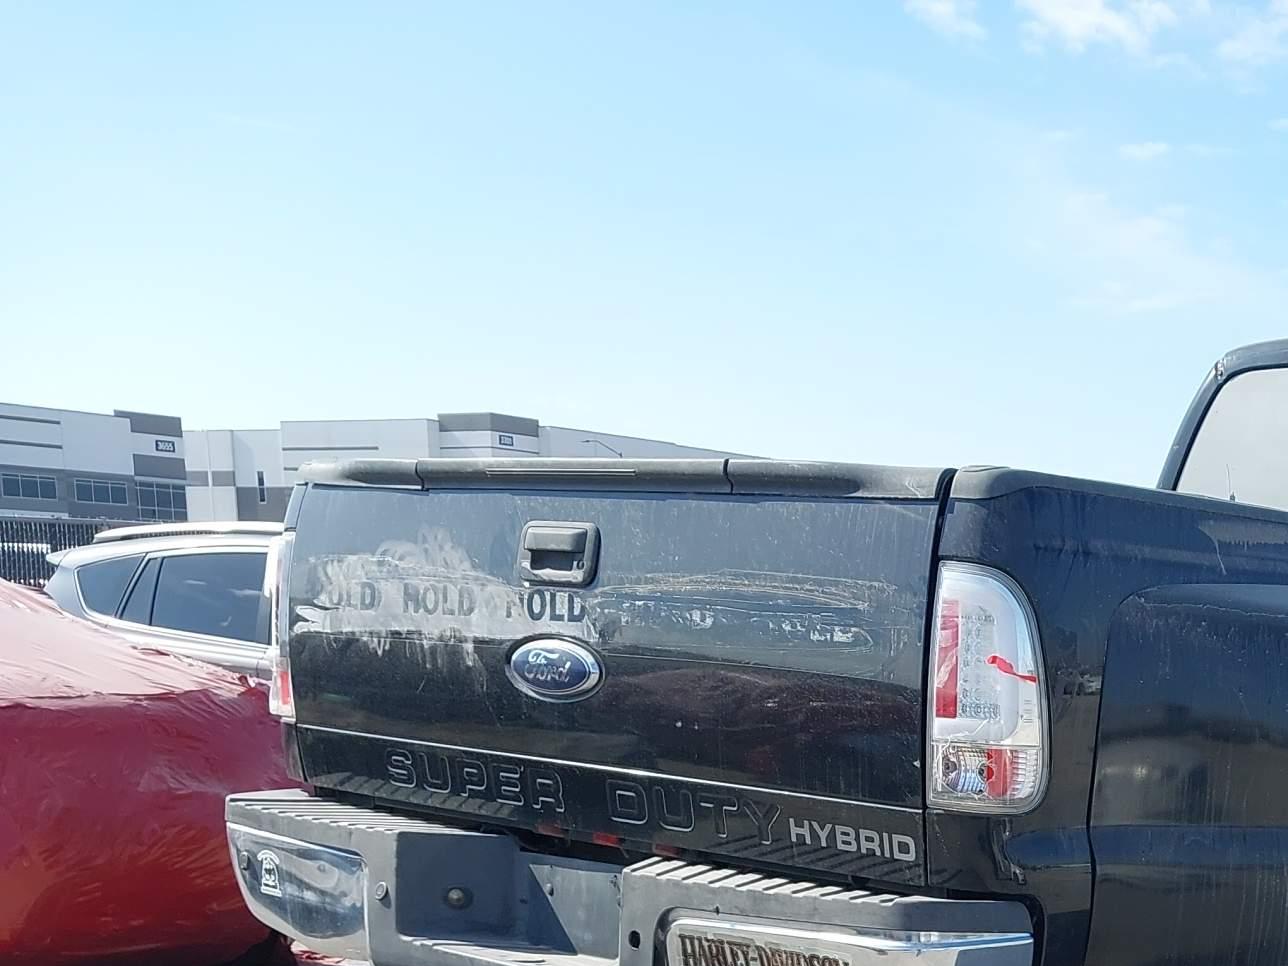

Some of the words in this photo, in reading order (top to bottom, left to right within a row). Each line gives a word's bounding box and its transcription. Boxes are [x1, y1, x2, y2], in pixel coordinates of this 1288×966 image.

[402, 582, 475, 617] HOLD
[523, 650, 571, 683] Ford
[384, 749, 565, 812] SUPER
[605, 778, 781, 845] DUTY
[789, 817, 916, 861] HYBRID
